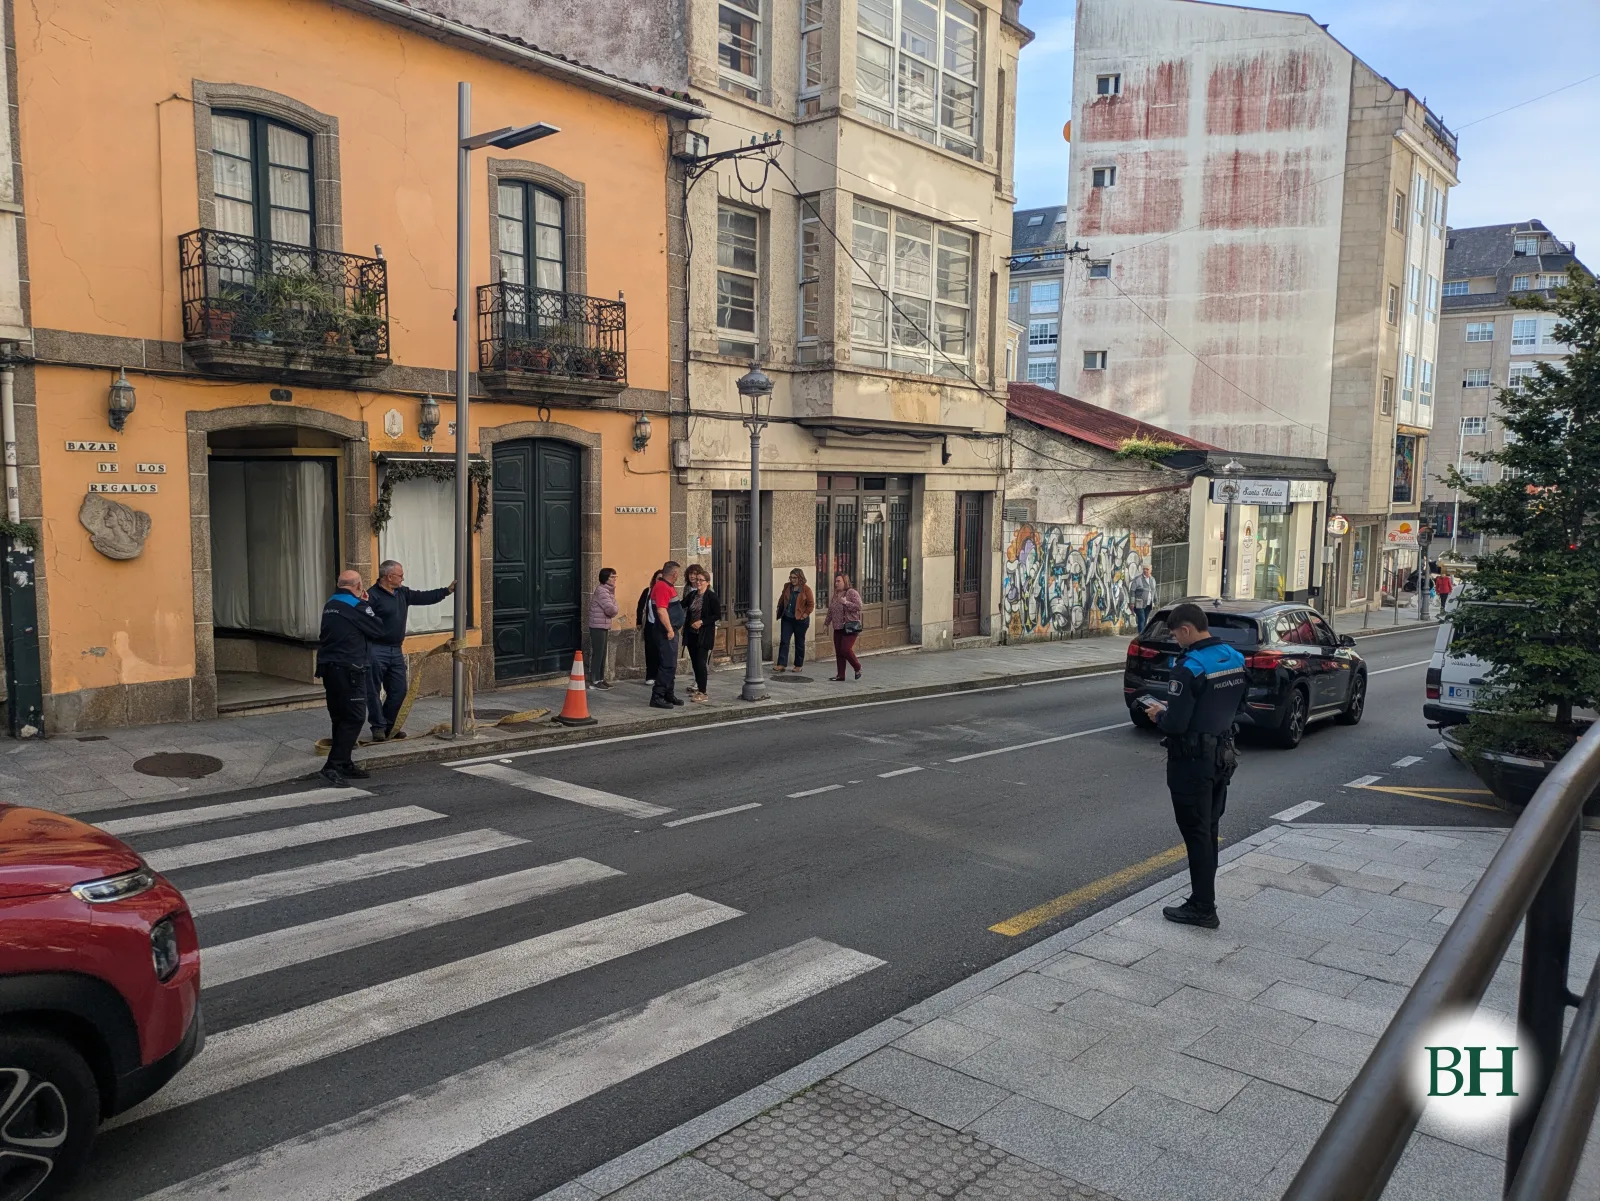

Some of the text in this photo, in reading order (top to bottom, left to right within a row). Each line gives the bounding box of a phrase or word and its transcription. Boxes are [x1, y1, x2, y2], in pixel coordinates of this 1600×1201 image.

[67, 442, 116, 451] BAZAR
[100, 463, 165, 472] DE LOS
[740, 477, 748, 486] 19
[90, 484, 157, 492] REGALOS
[1243, 486, 1260, 496] Santa
[1455, 688, 1462, 697] C
